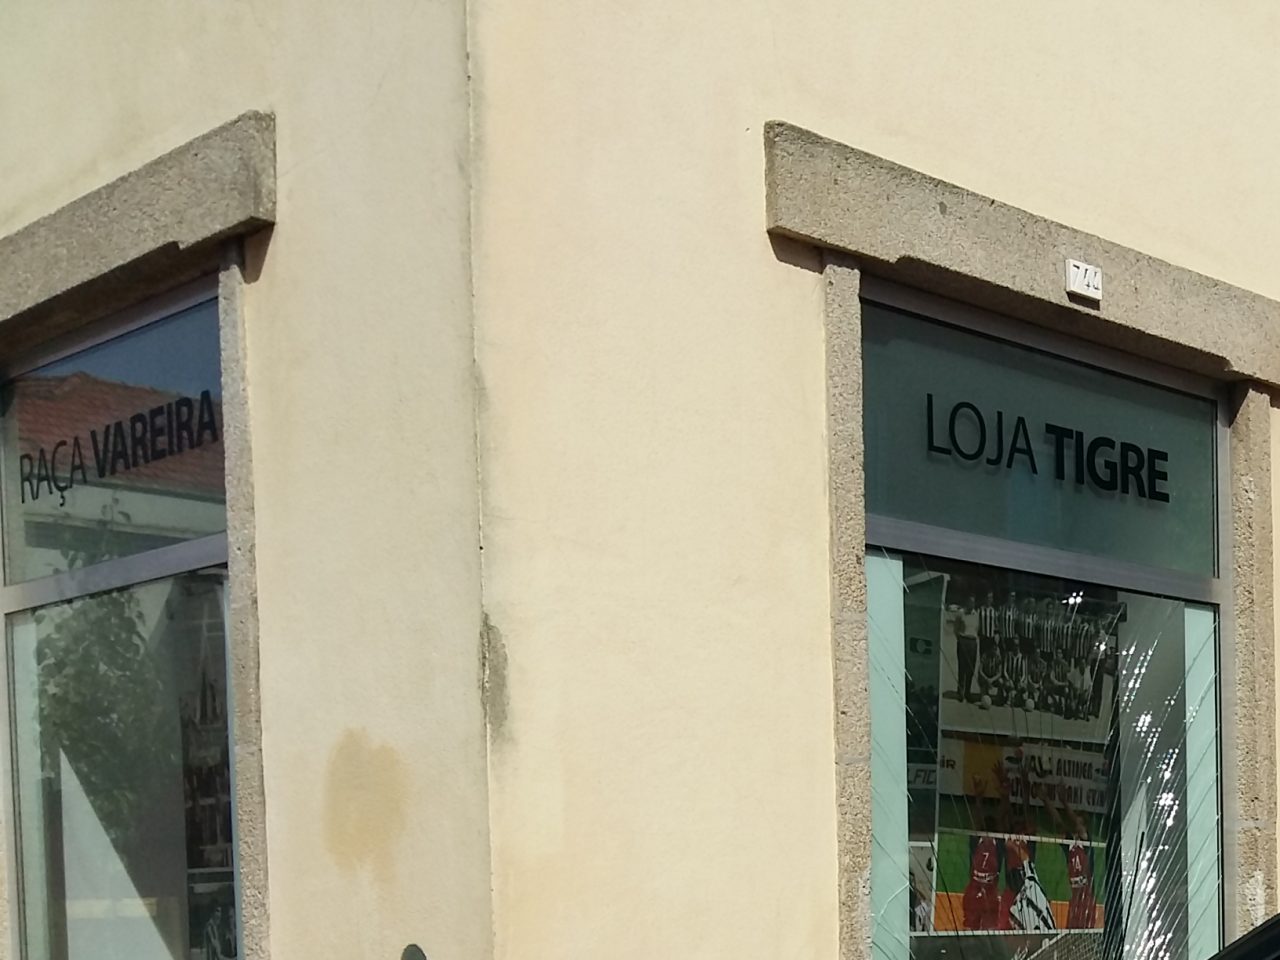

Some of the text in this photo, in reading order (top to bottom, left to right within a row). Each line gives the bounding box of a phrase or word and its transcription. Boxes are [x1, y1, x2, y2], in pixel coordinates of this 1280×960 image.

[20, 389, 219, 508] RAÇA VAREIRA
[927, 393, 1171, 504] LOJA TIGRE
